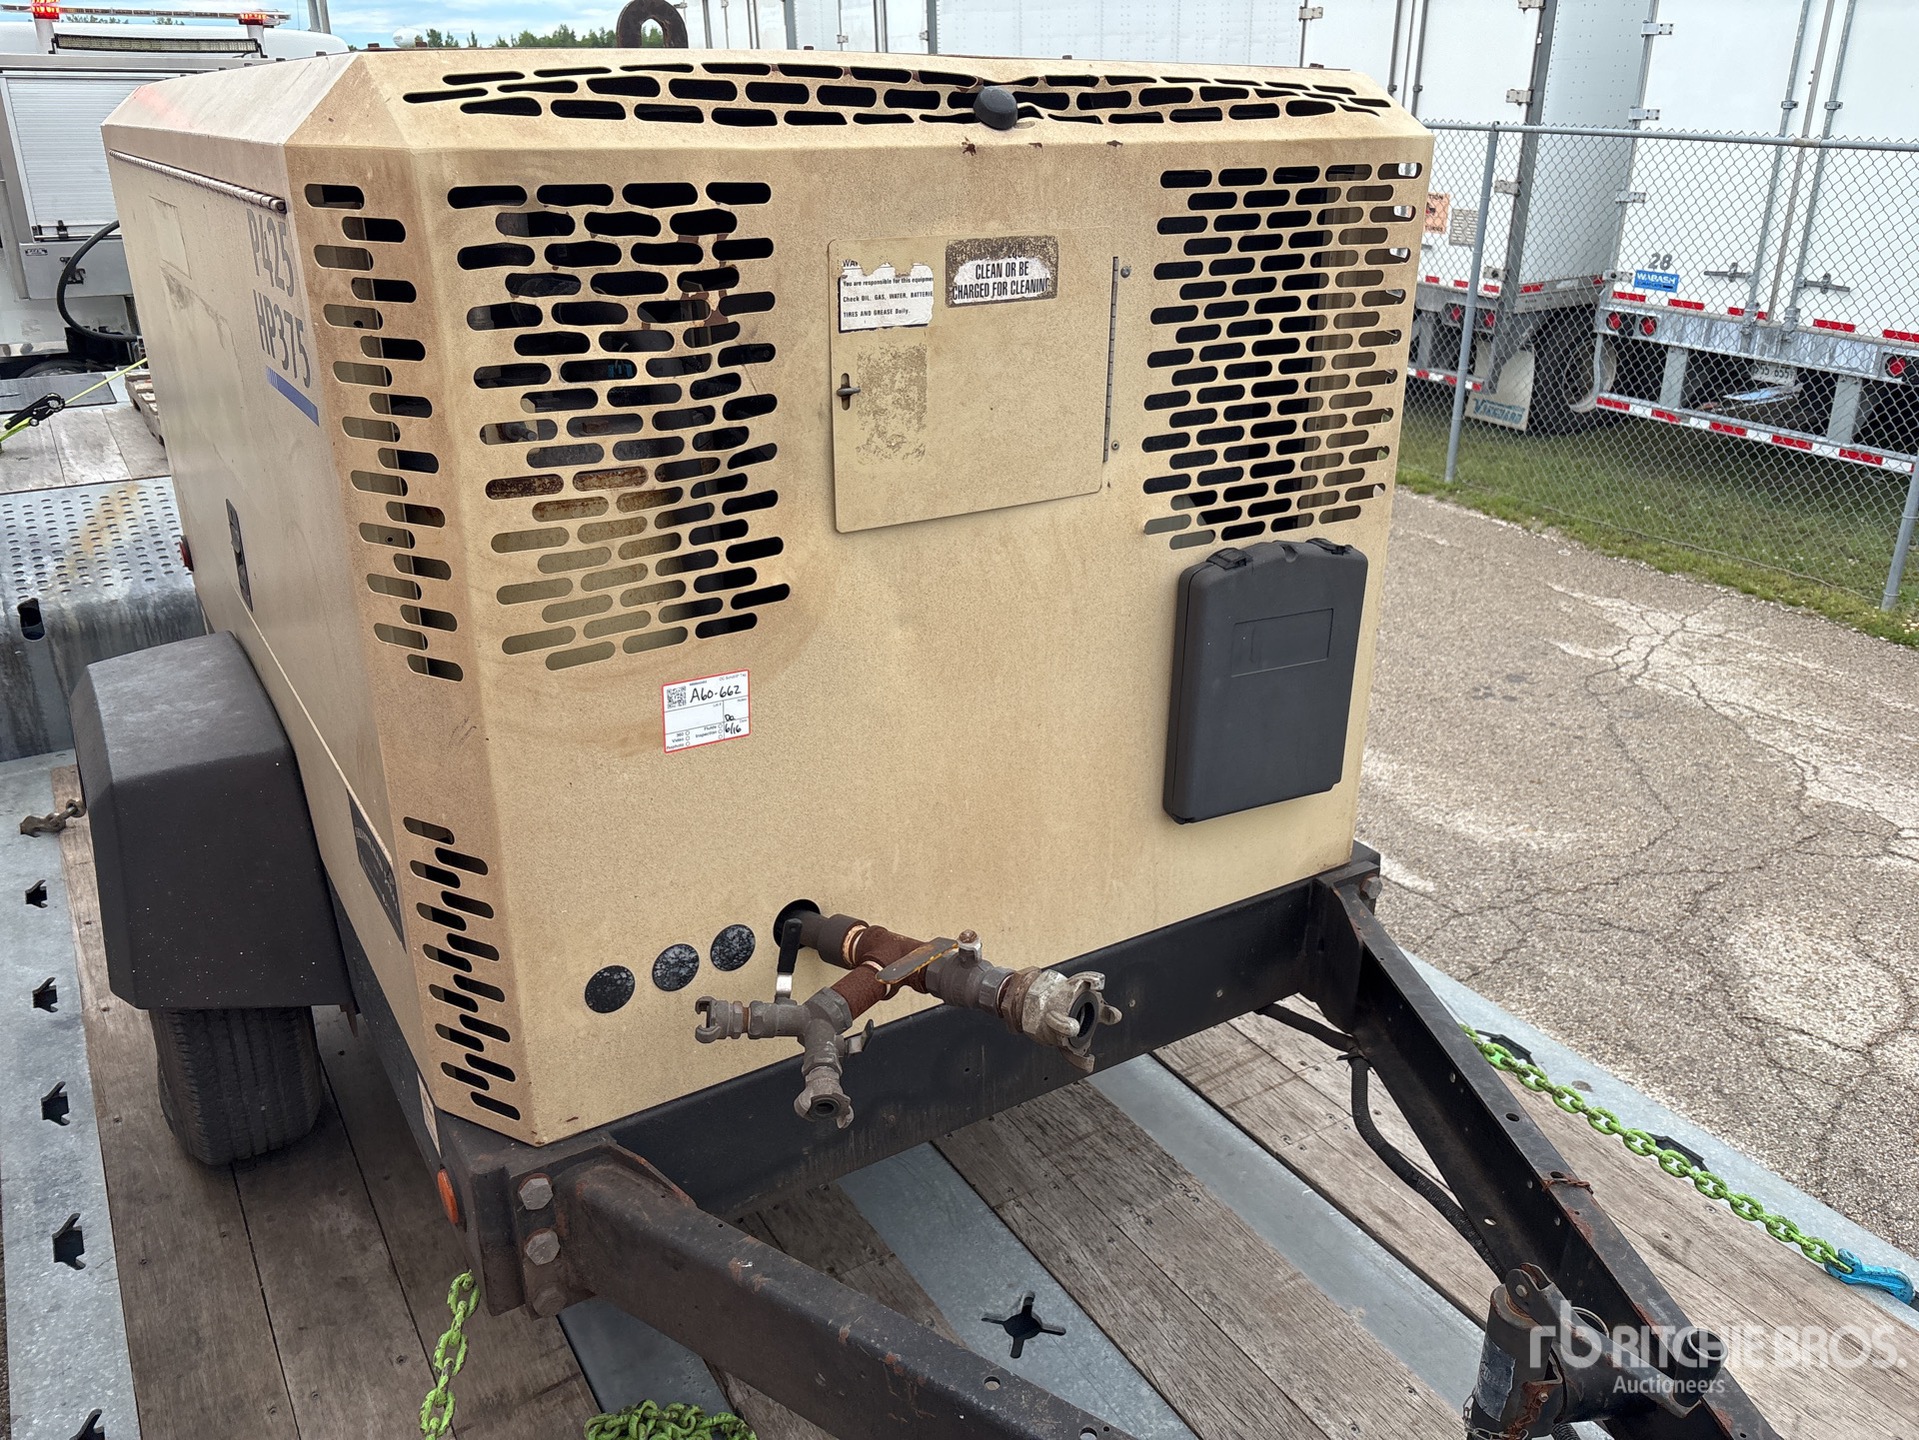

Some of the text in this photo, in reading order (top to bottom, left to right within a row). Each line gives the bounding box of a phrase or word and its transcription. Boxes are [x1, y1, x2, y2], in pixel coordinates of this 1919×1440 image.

[247, 208, 294, 298] P425
[1647, 252, 1673, 271] 28
[975, 261, 1030, 280] CLEAN OR BE
[1636, 272, 1677, 285] WABASH
[863, 279, 892, 287] responsible
[952, 282, 990, 300] CHARGED
[991, 281, 1008, 298] FOR
[843, 295, 859, 303] Check
[873, 308, 893, 316] GREASE
[252, 289, 311, 389] HP375
[689, 685, 741, 703] A60-662
